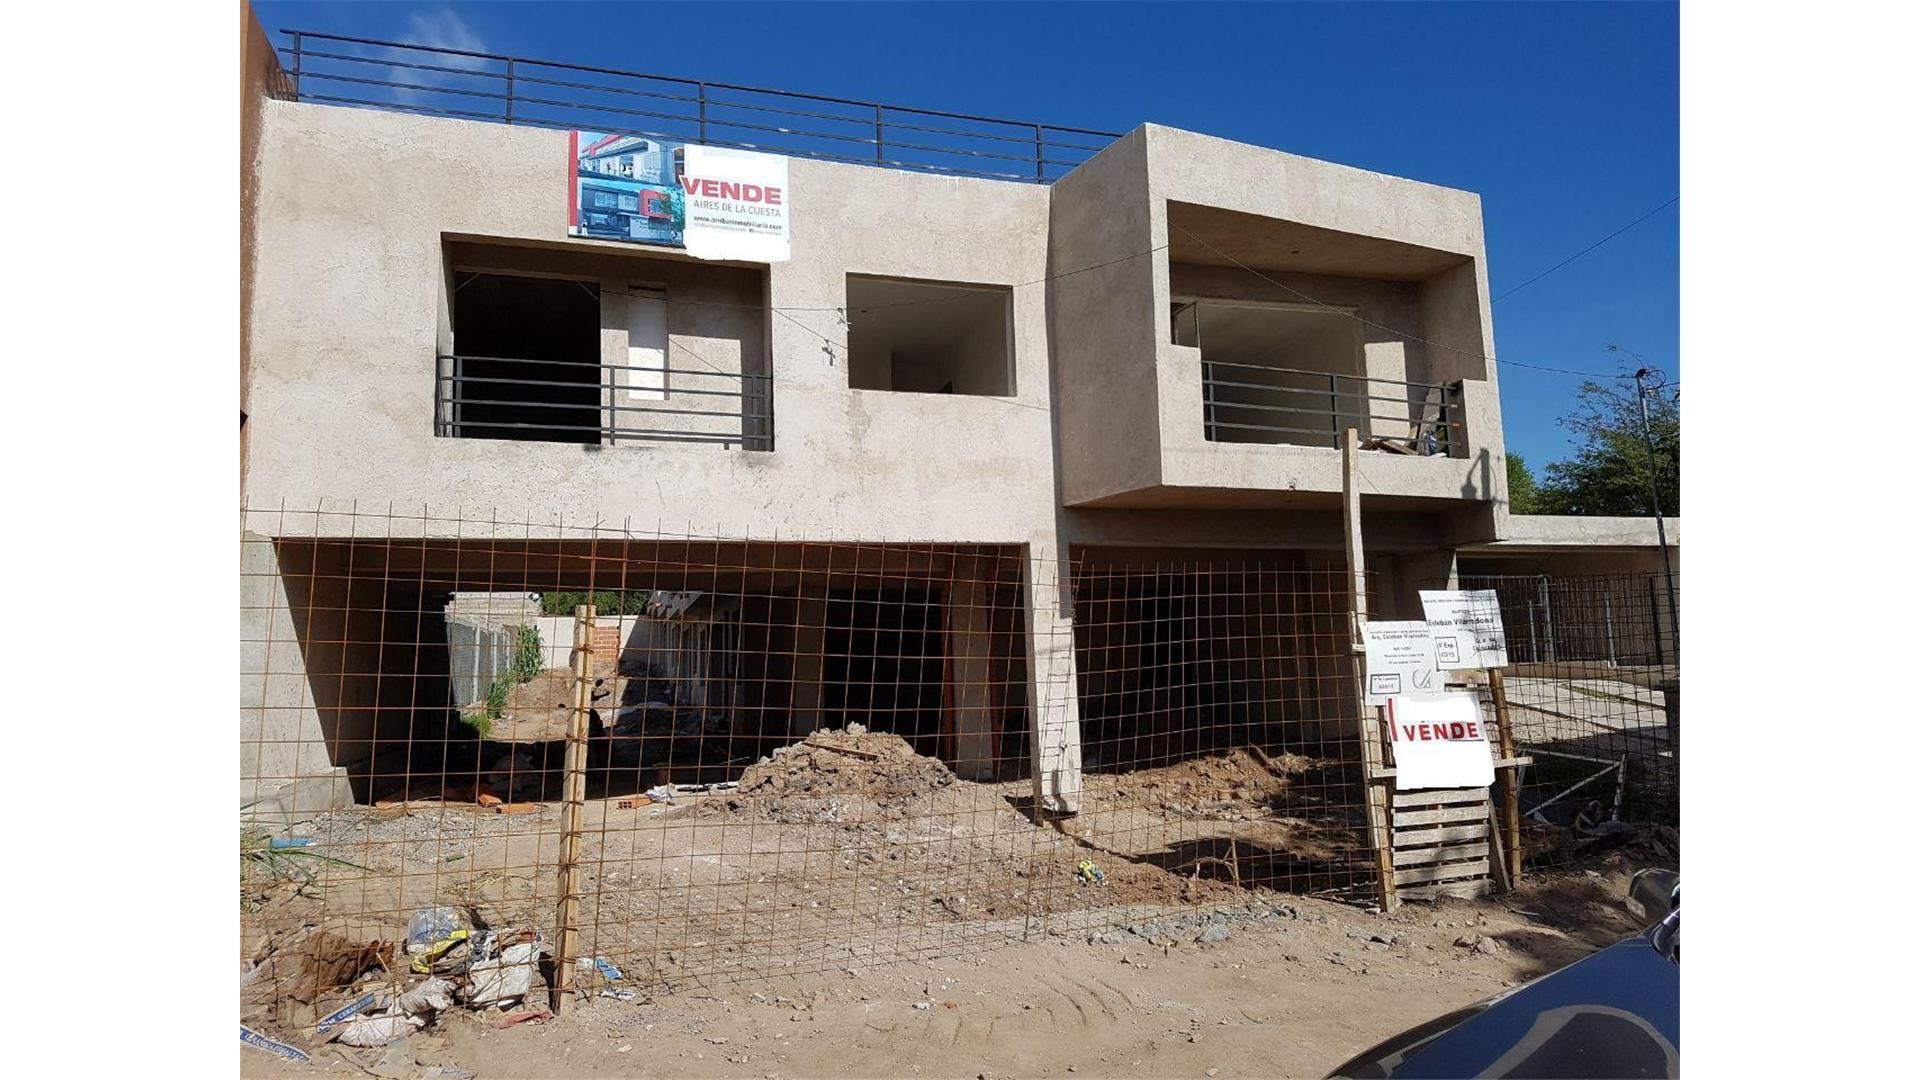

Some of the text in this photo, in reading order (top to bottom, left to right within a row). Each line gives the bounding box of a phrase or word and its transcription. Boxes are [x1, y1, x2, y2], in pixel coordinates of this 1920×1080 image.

[681, 176, 782, 205] VENDE
[693, 199, 782, 218] AIRES DE LA CUESTA
[1402, 721, 1479, 742] VENDE
